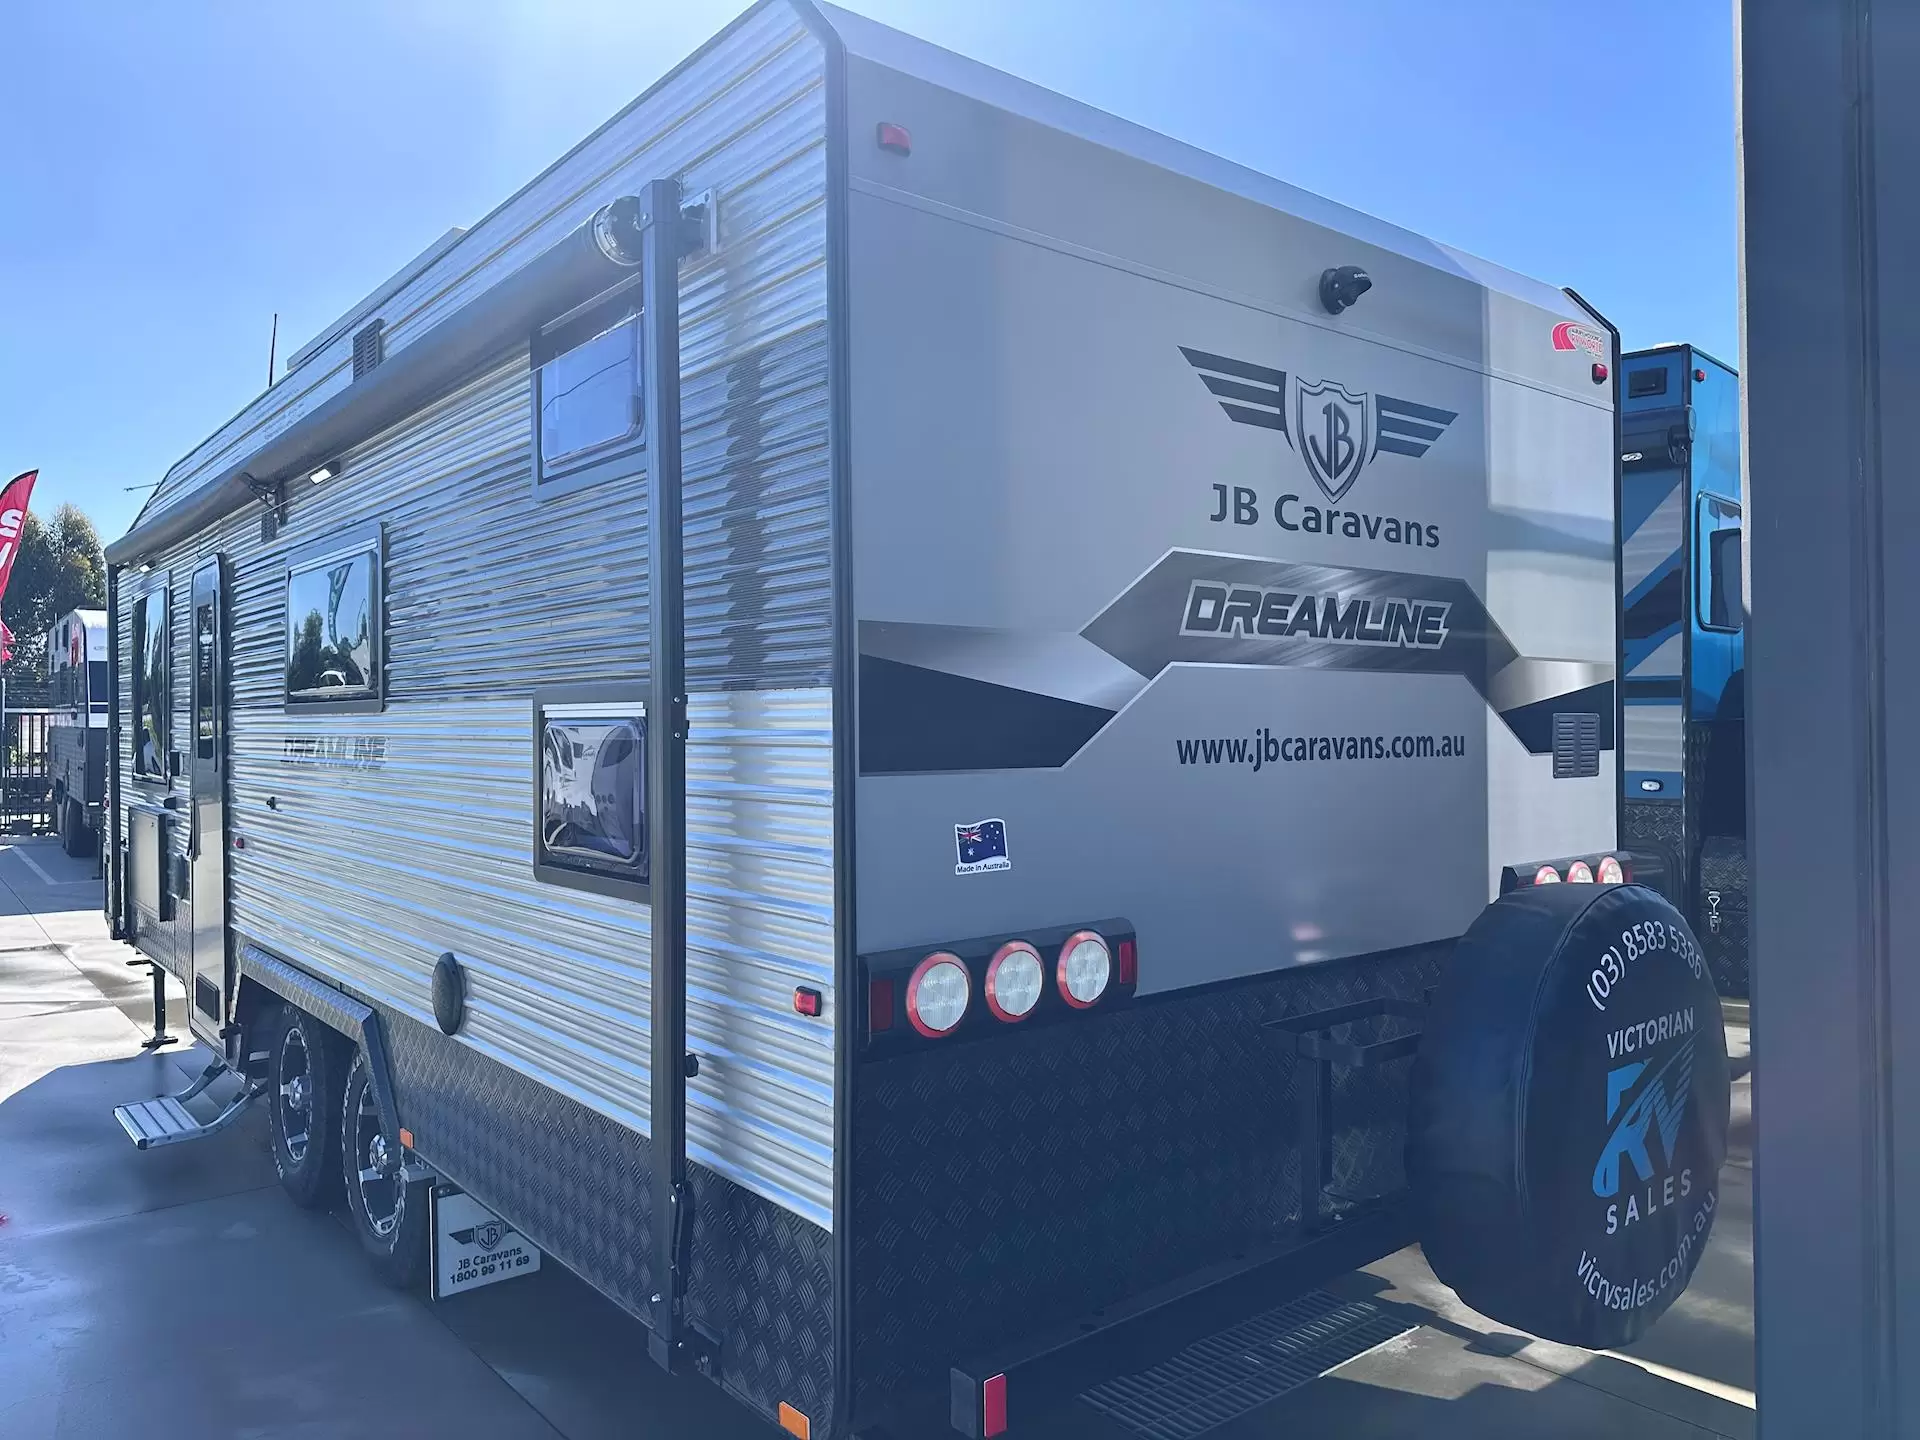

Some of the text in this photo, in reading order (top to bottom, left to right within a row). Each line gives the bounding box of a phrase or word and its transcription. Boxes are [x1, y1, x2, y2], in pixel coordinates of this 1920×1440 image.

[1310, 402, 1354, 481] JB
[1210, 483, 1440, 548] JB Caravans
[1180, 579, 1453, 650] DREAMLINE
[1176, 728, 1466, 772] www.jbcaravans.com.au
[957, 865, 975, 873] Made
[983, 861, 1009, 870] Australia
[1587, 920, 1702, 1011] (03) 8583 5386
[1607, 1006, 1694, 1059] VICTORIAN
[1606, 1168, 1692, 1235] SALES
[457, 1246, 522, 1271] JB Caravans
[480, 1227, 499, 1246] JB
[1577, 1190, 1717, 1311] vicrvsales.com.au
[450, 1269, 478, 1284] 1800
[481, 1263, 495, 1275] 99
[500, 1259, 512, 1271] 11
